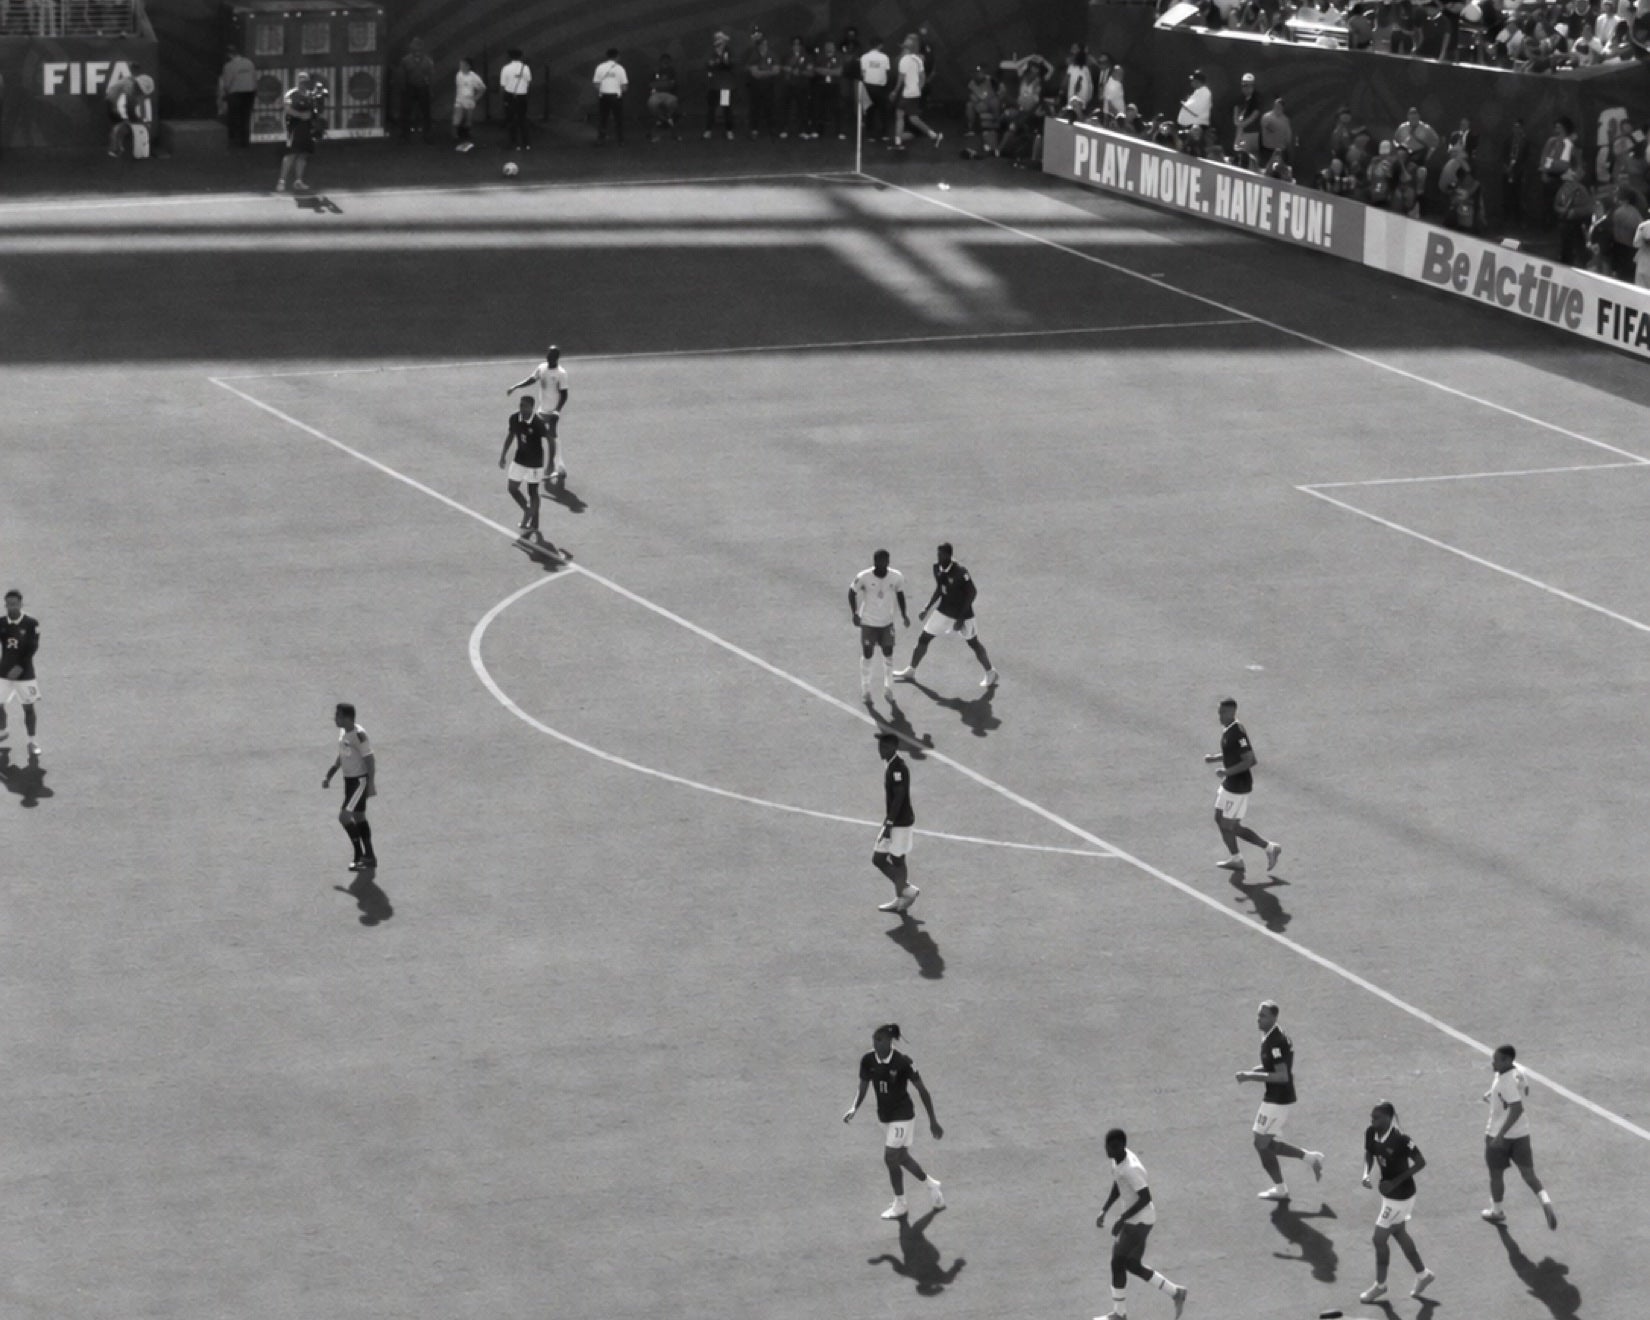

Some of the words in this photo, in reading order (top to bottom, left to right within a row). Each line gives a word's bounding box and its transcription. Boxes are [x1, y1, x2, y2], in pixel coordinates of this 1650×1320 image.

[43, 61, 132, 96] FIFA
[1074, 134, 1134, 192] PLAY.
[1140, 152, 1209, 214] MOVE.
[1215, 174, 1273, 231] HAVE
[1278, 191, 1333, 248] FUN!
[1422, 231, 1471, 292] Be
[1473, 249, 1584, 330] Active
[1597, 297, 1650, 351] FIFA
